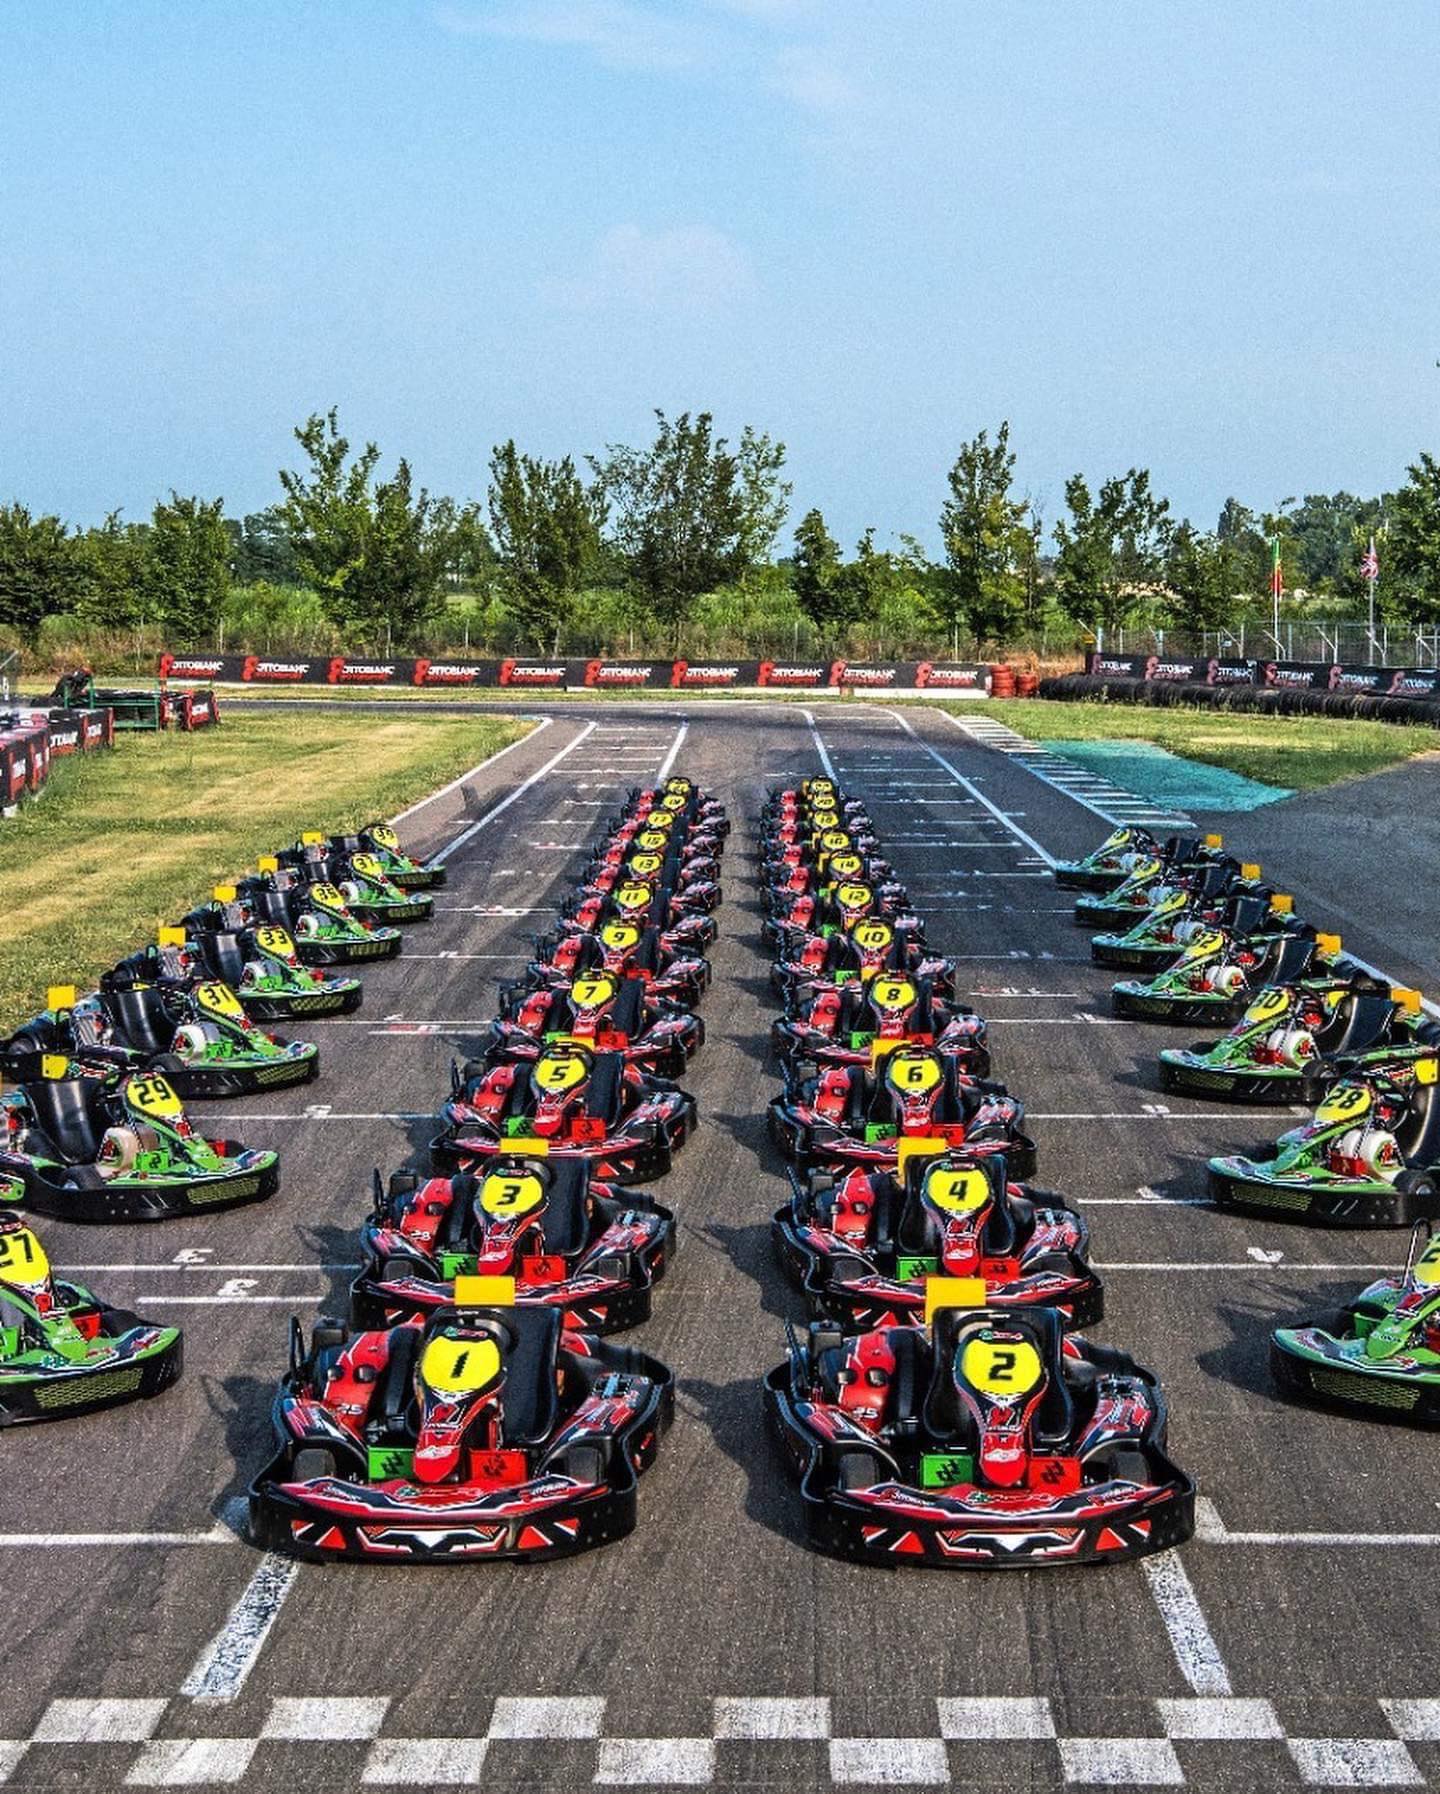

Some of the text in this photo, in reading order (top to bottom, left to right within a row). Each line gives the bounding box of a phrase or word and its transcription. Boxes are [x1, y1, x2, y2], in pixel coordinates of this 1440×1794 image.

[840, 860, 855, 869] 14
[626, 892, 639, 902] 11
[849, 890, 865, 901] 12
[263, 929, 288, 946] 33
[613, 932, 625, 943] 9
[863, 931, 885, 943] 10
[203, 986, 231, 1006] 31
[585, 986, 597, 1000] 7
[886, 988, 901, 1001] 8
[549, 1065, 570, 1082] 5
[908, 1065, 923, 1083] 6
[133, 1078, 171, 1106] 29
[1323, 1088, 1364, 1110] 28
[496, 1185, 522, 1206] 3
[949, 1180, 969, 1202] 4
[450, 1350, 470, 1378] 1
[988, 1351, 1016, 1381] 2
